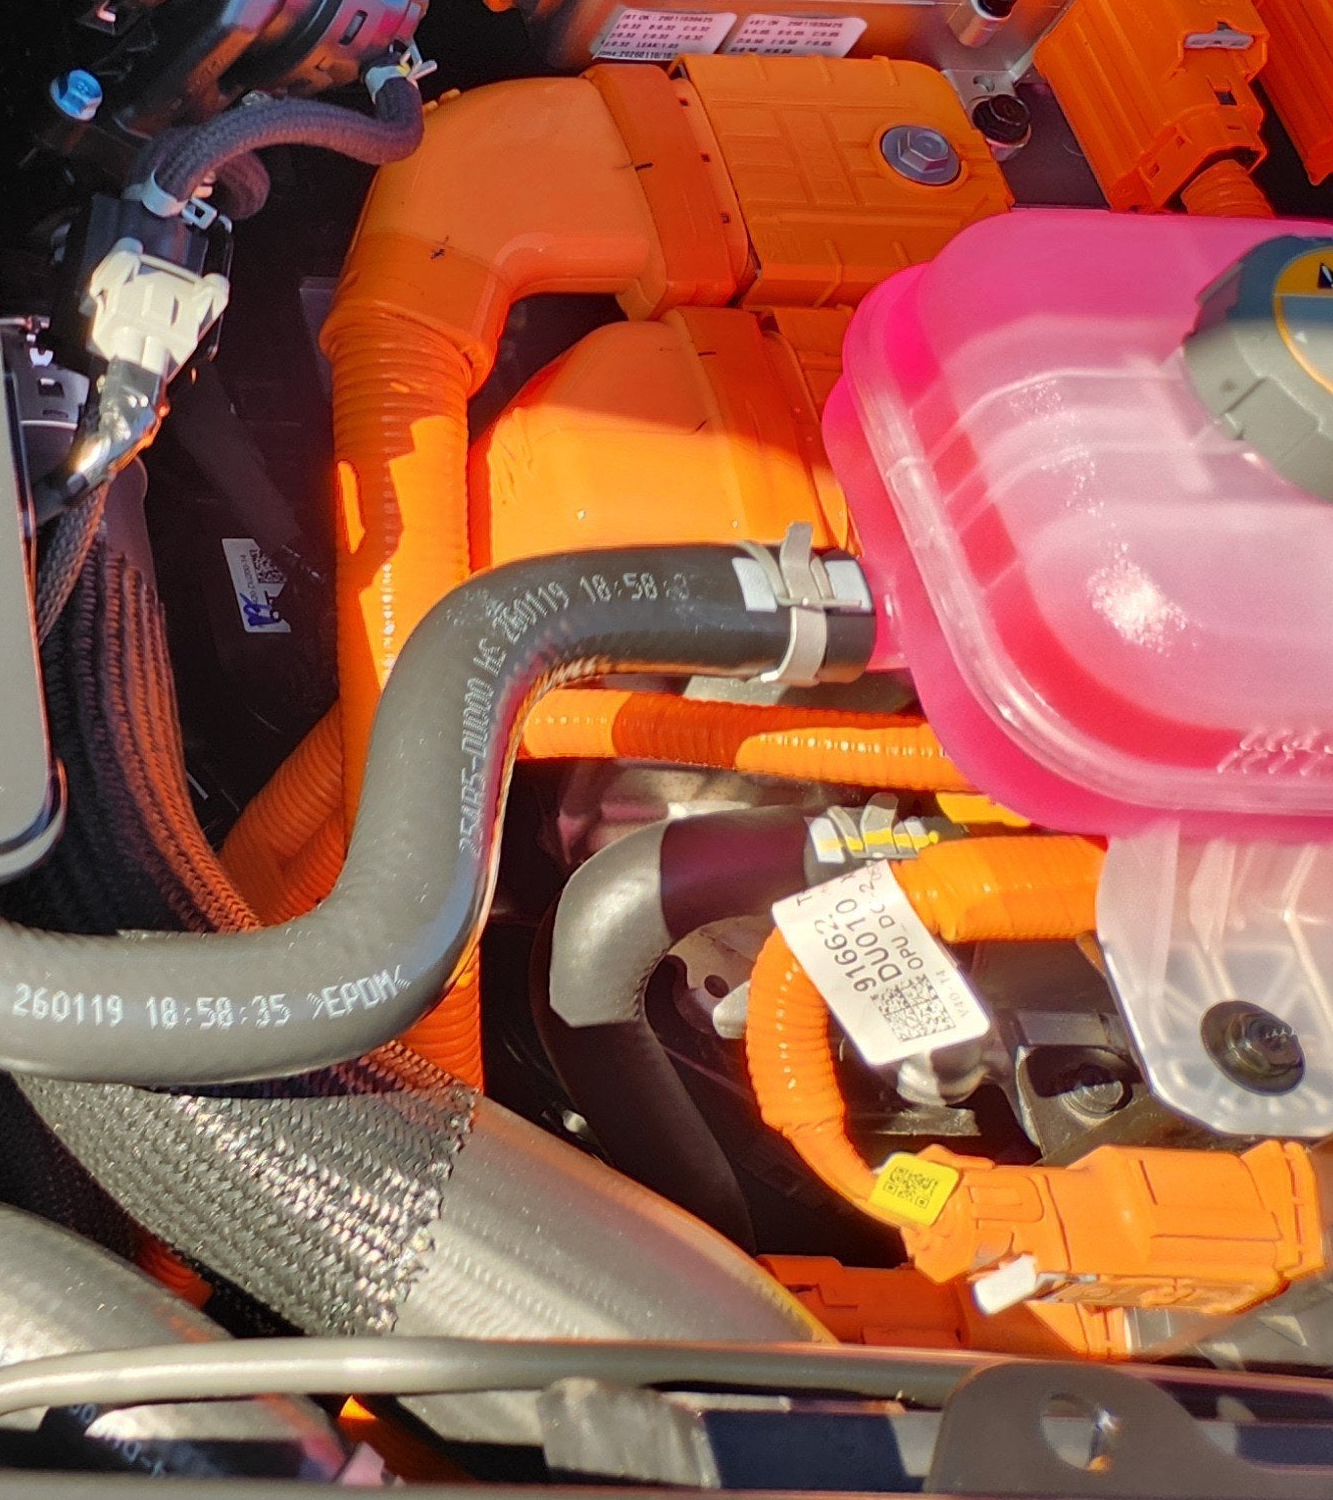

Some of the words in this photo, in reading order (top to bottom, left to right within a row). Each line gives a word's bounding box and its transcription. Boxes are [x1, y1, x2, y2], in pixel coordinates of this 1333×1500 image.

[835, 898, 903, 983] DU010
[12, 984, 124, 1026] 260119
[145, 993, 291, 1030] 18:58:35
